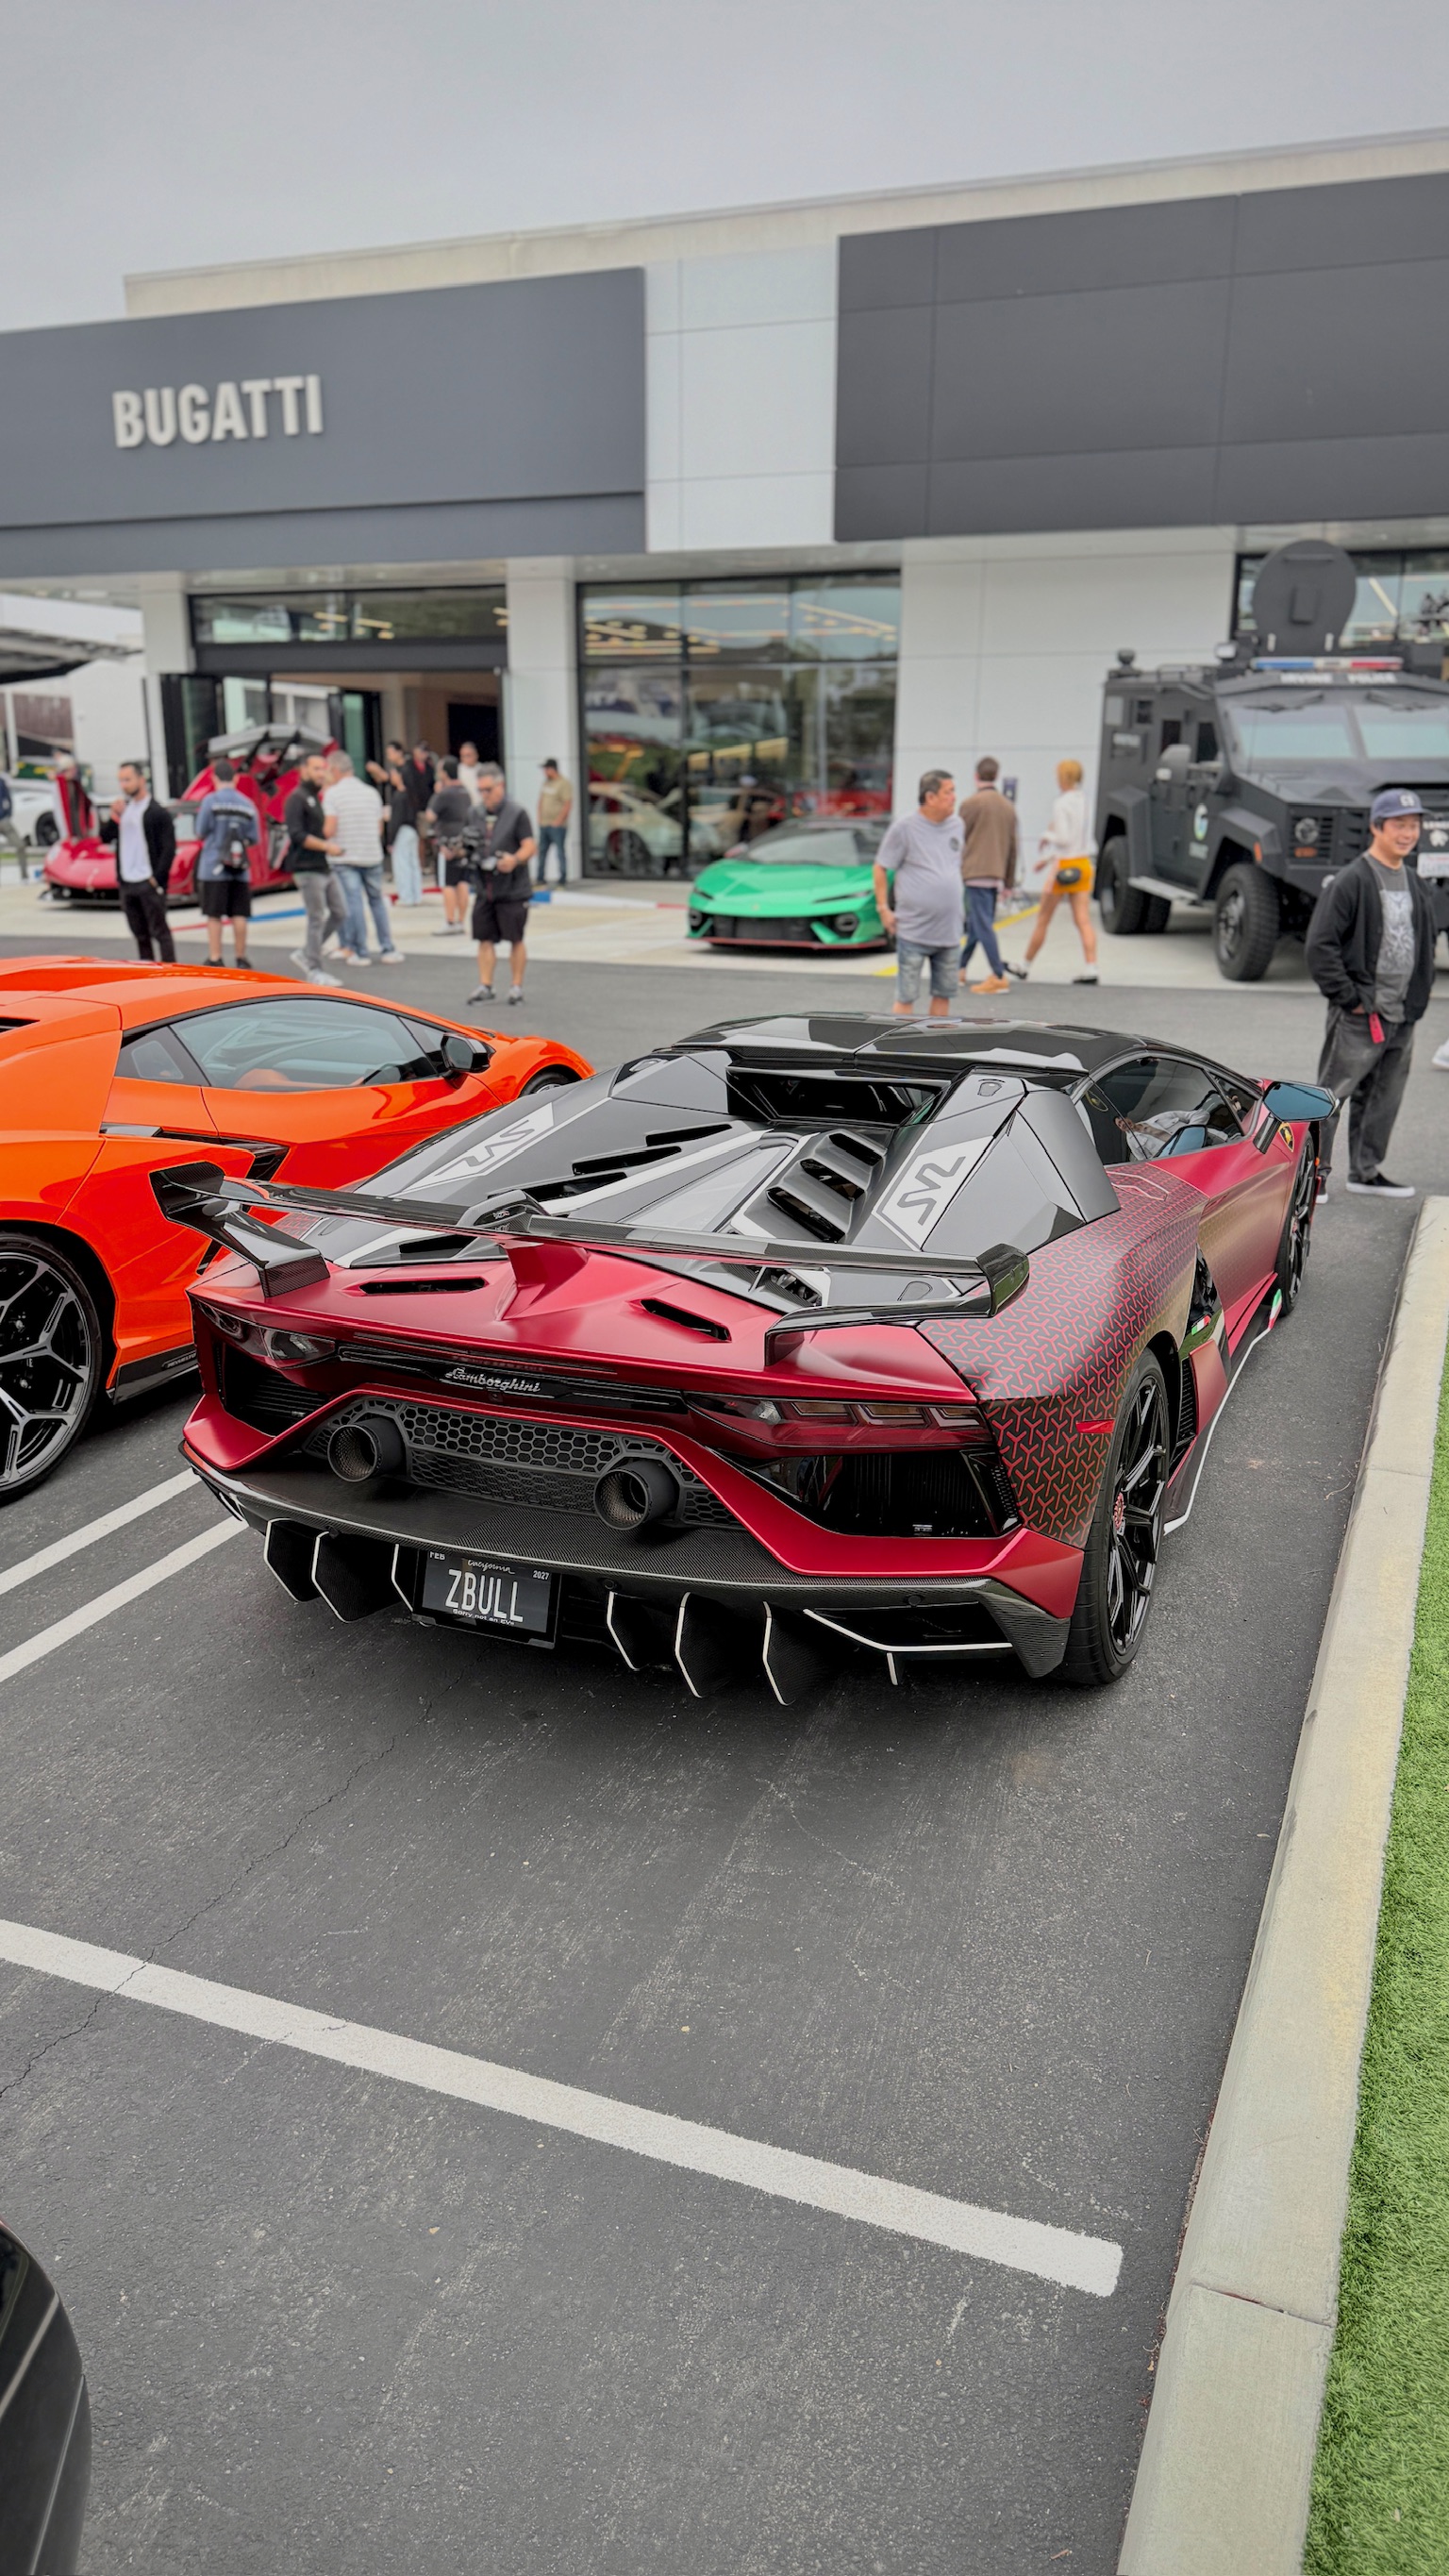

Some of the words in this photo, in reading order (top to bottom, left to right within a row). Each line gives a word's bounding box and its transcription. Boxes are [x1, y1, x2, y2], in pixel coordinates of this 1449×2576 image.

[111, 374, 324, 448] BUGATTI
[1347, 672, 1397, 684] POLICE
[444, 1366, 541, 1393] Lamborghini
[532, 1570, 550, 1581] 2027
[445, 1568, 524, 1623] ZBULL
